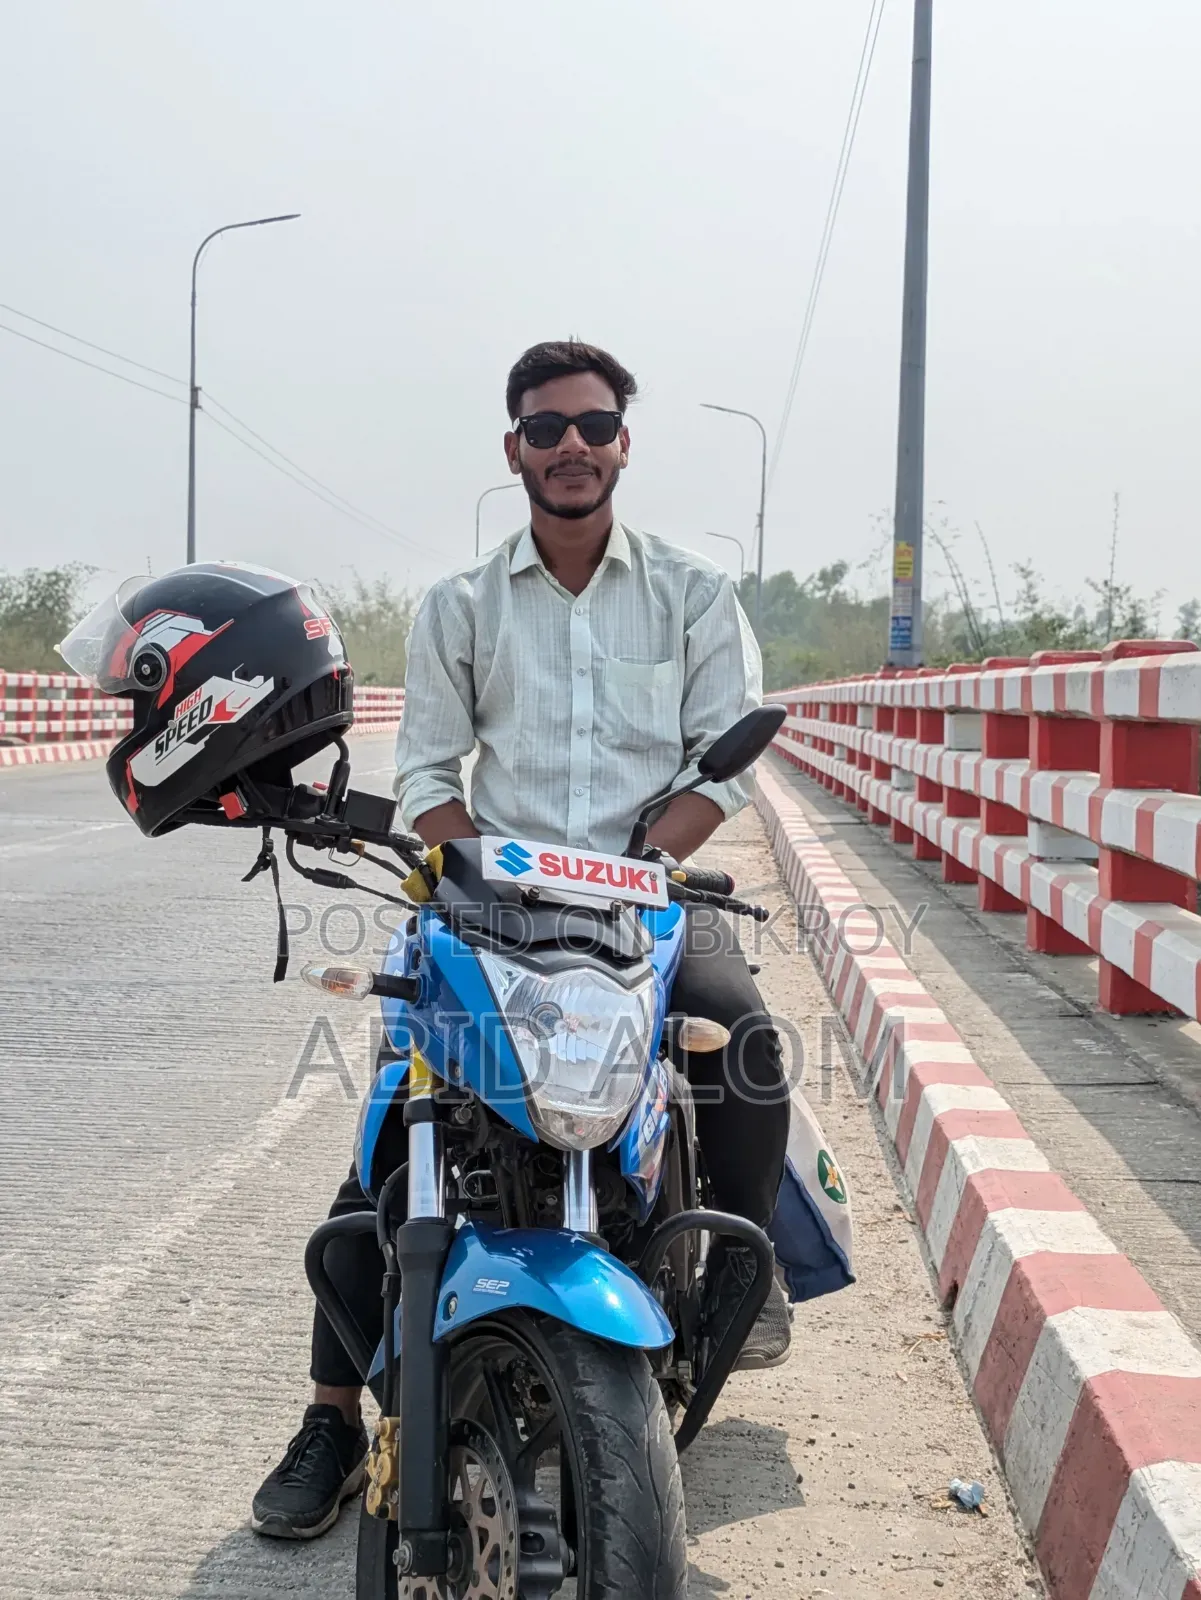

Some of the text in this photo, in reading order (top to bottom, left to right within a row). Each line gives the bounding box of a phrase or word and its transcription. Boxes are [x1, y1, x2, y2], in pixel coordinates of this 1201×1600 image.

[175, 686, 203, 719] HIGH
[155, 694, 214, 761] SPEED
[538, 852, 659, 894] SUZUKI
[475, 1278, 510, 1290] SEP
